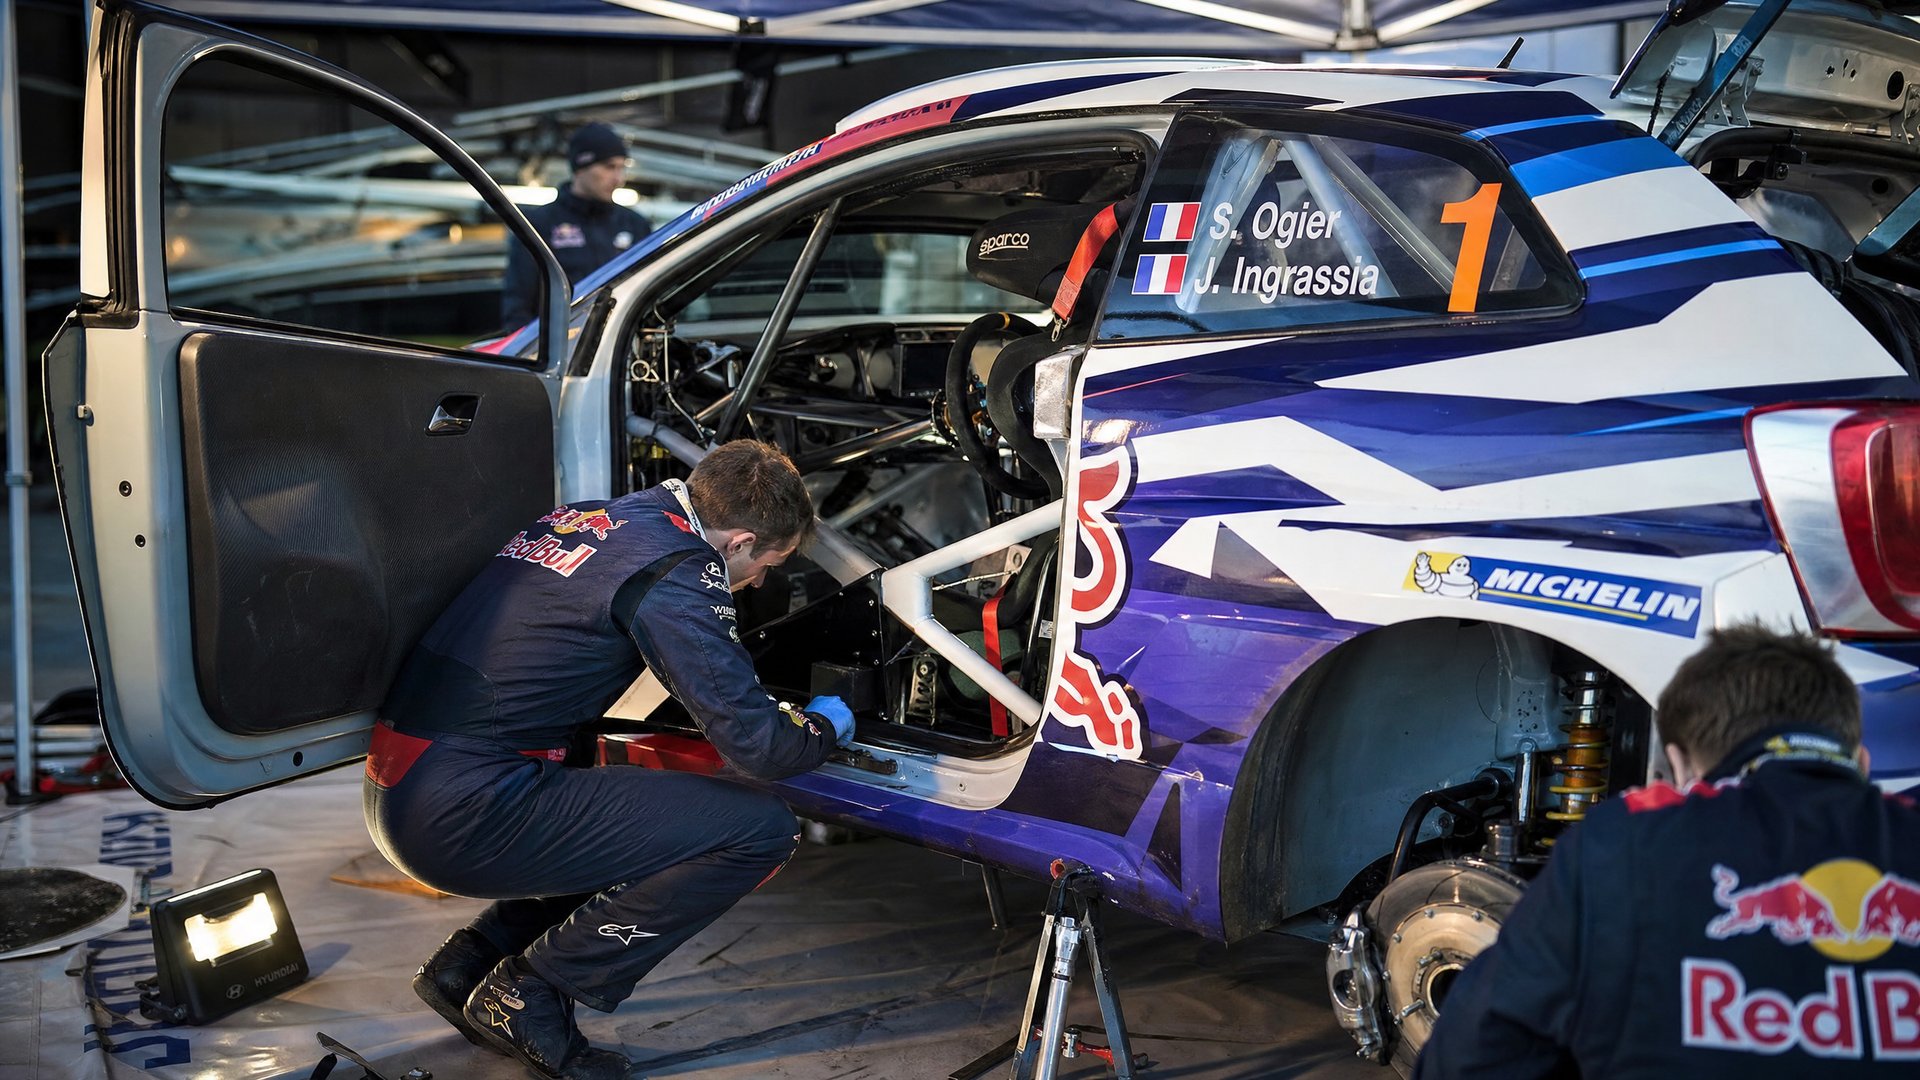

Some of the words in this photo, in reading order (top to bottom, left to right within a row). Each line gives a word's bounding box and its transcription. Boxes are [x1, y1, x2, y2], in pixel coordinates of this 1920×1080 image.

[979, 233, 1030, 254] sparco
[1209, 201, 1238, 240] S.
[1252, 201, 1341, 249] Ogier
[1440, 182, 1503, 312] 1
[1194, 256, 1220, 295] J.
[1232, 255, 1380, 304] Ingrassia
[1483, 567, 1700, 622] MICHELIN
[1683, 958, 1862, 1058] Red
